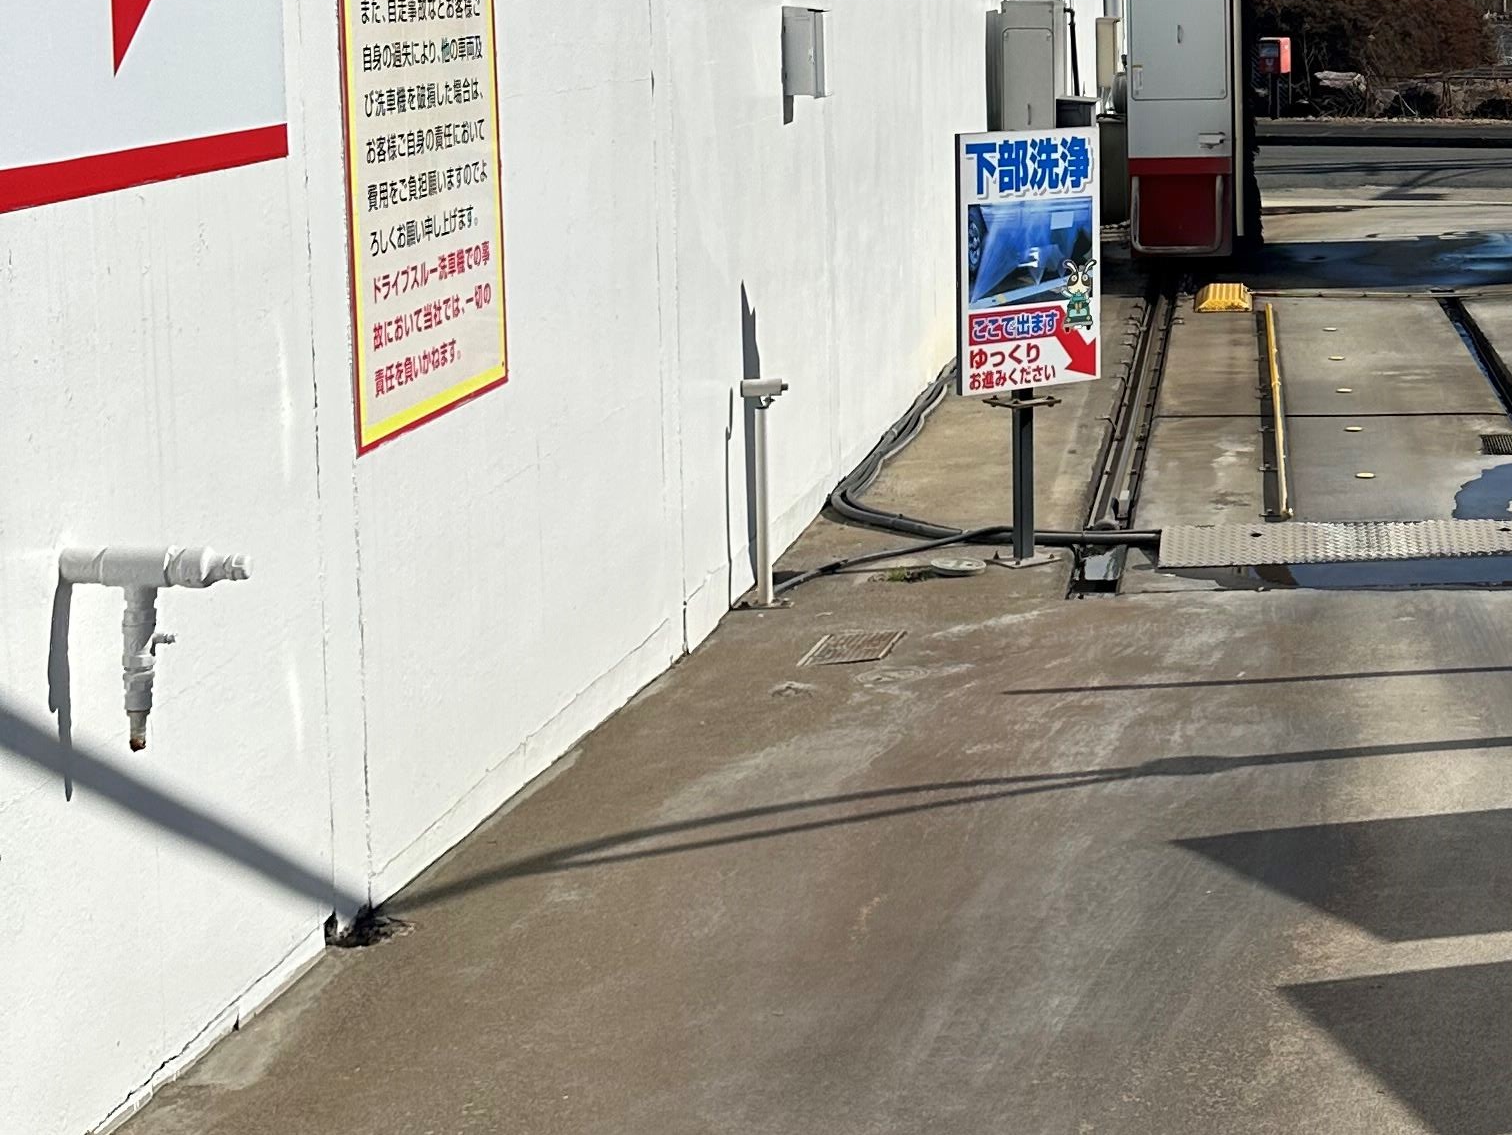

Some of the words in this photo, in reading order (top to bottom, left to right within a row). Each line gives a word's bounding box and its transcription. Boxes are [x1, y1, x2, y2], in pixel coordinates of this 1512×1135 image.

[362, 34, 483, 72] 自身の過失により、他の車両及
[364, 77, 484, 118] び洗車機を破損した場合は、
[366, 118, 486, 165] お客様ご自身の責任において
[965, 136, 1090, 195] 下部洗浄
[367, 160, 488, 212] 費用をご負担願いますのでよ
[369, 206, 479, 257] ろしくお願い申し上げます。
[372, 240, 490, 304] ドライブスルー洗車機での事
[372, 283, 491, 352] 故において当社では、一切の
[972, 311, 1058, 341] ここで出ます
[374, 338, 462, 398] 責任を負いかねます。
[969, 342, 1041, 370] ゆっくり
[969, 364, 1056, 391] お進みください
